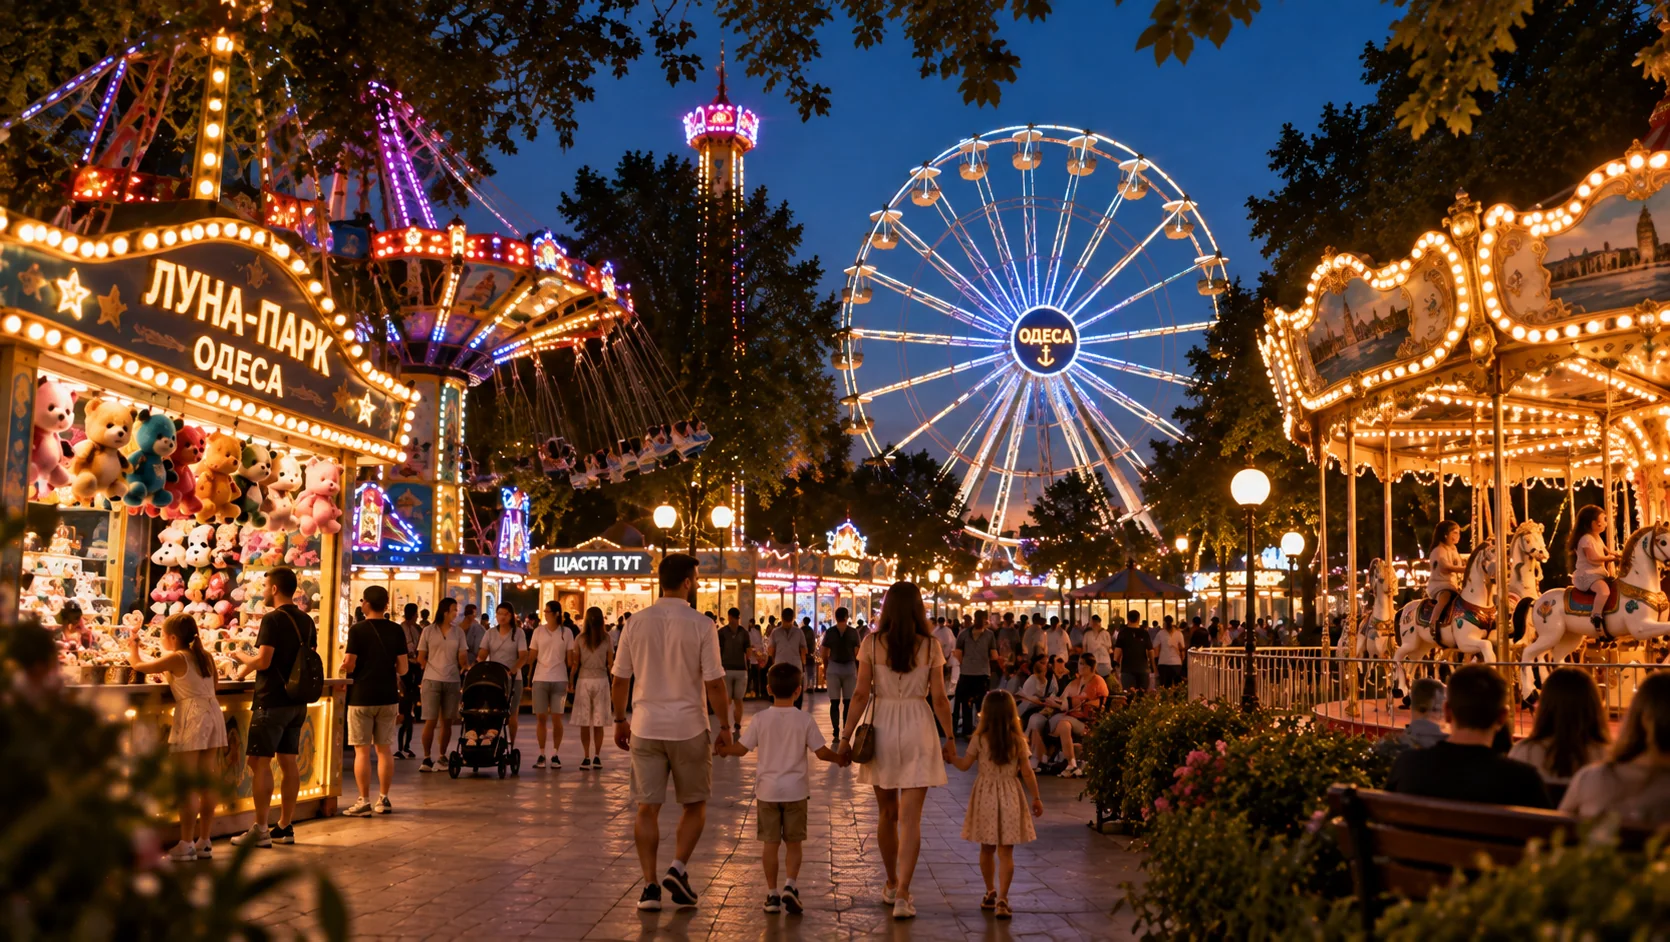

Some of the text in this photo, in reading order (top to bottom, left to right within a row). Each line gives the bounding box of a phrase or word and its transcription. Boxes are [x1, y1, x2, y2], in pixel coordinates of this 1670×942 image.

[145, 259, 333, 377] ЛУНА-ПАРК
[1019, 328, 1073, 345] ОДЕСА
[194, 336, 283, 398] ОДЕСА
[612, 556, 642, 570] ТУТ
